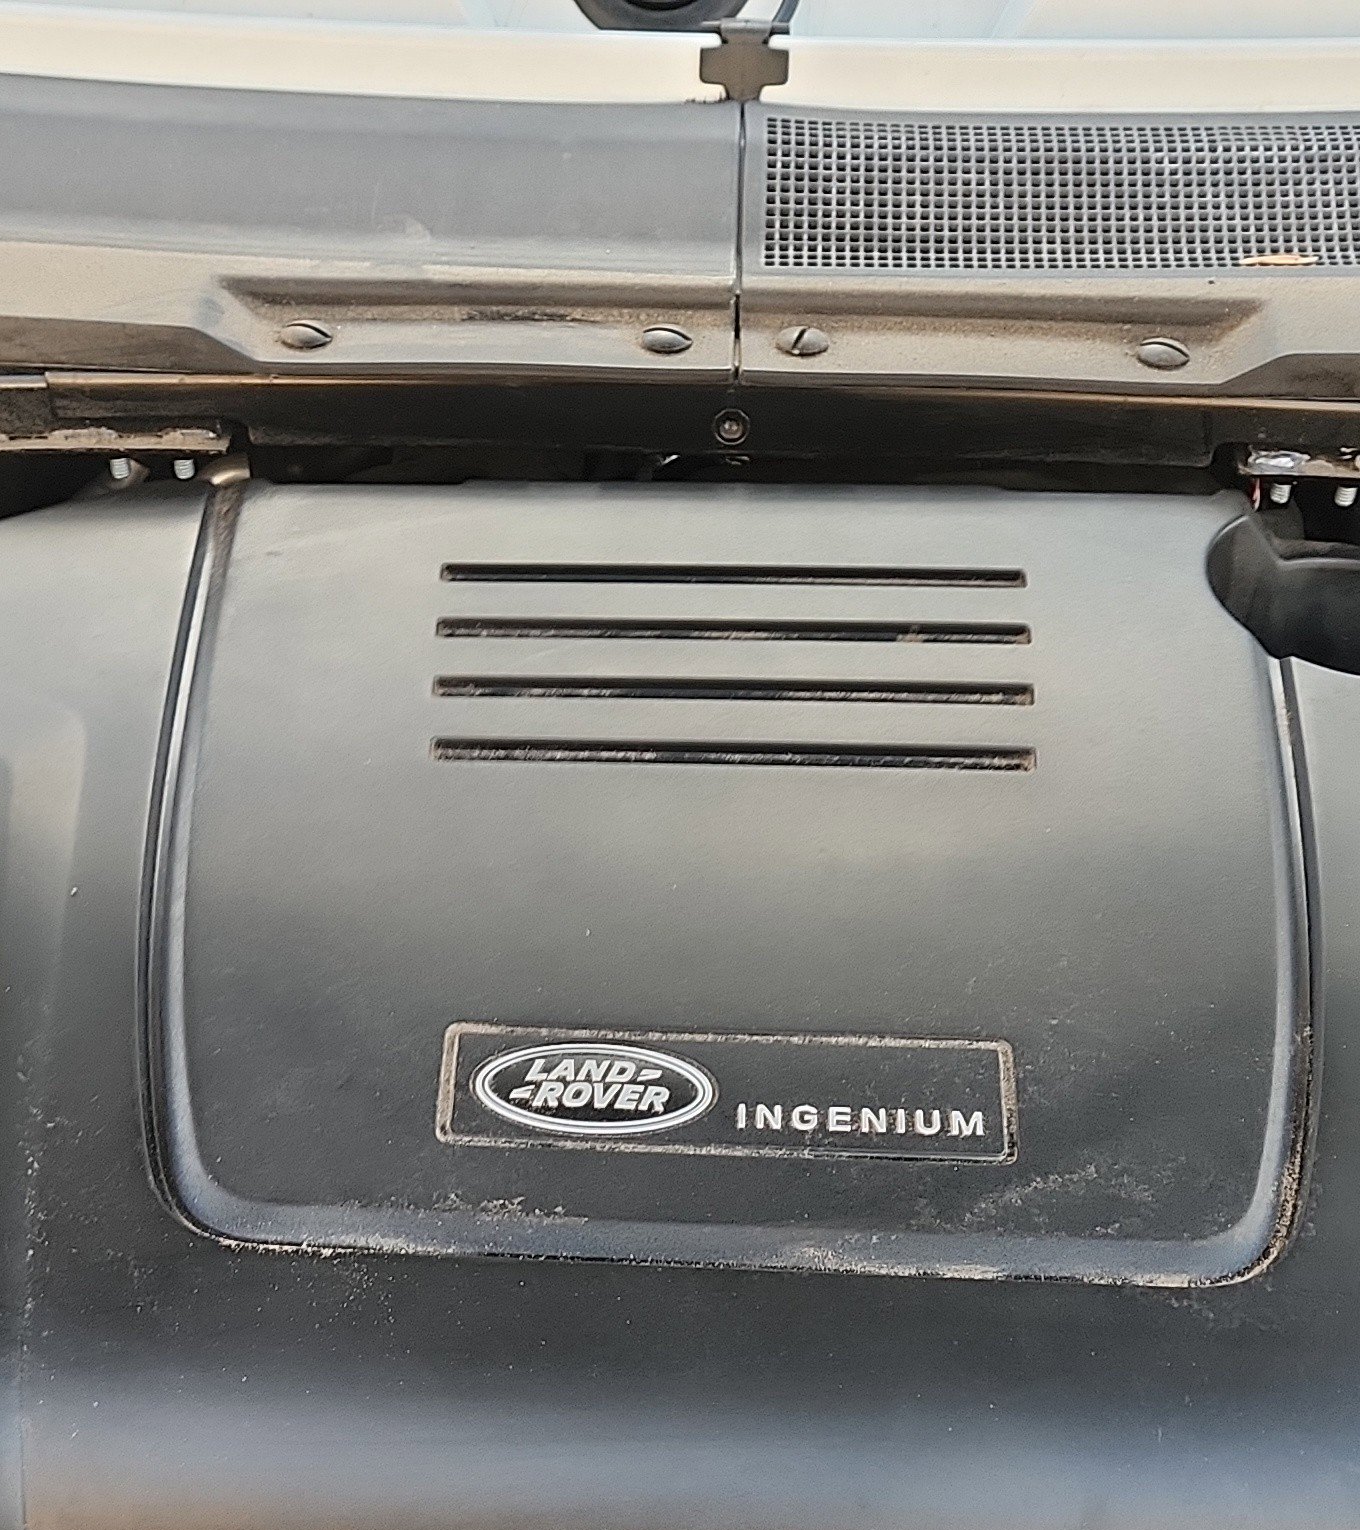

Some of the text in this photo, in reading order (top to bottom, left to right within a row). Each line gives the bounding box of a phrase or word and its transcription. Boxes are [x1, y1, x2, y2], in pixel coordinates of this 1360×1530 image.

[524, 1058, 636, 1083] LAND
[532, 1081, 670, 1113] ROVER
[736, 1102, 986, 1137] INGENIUM
